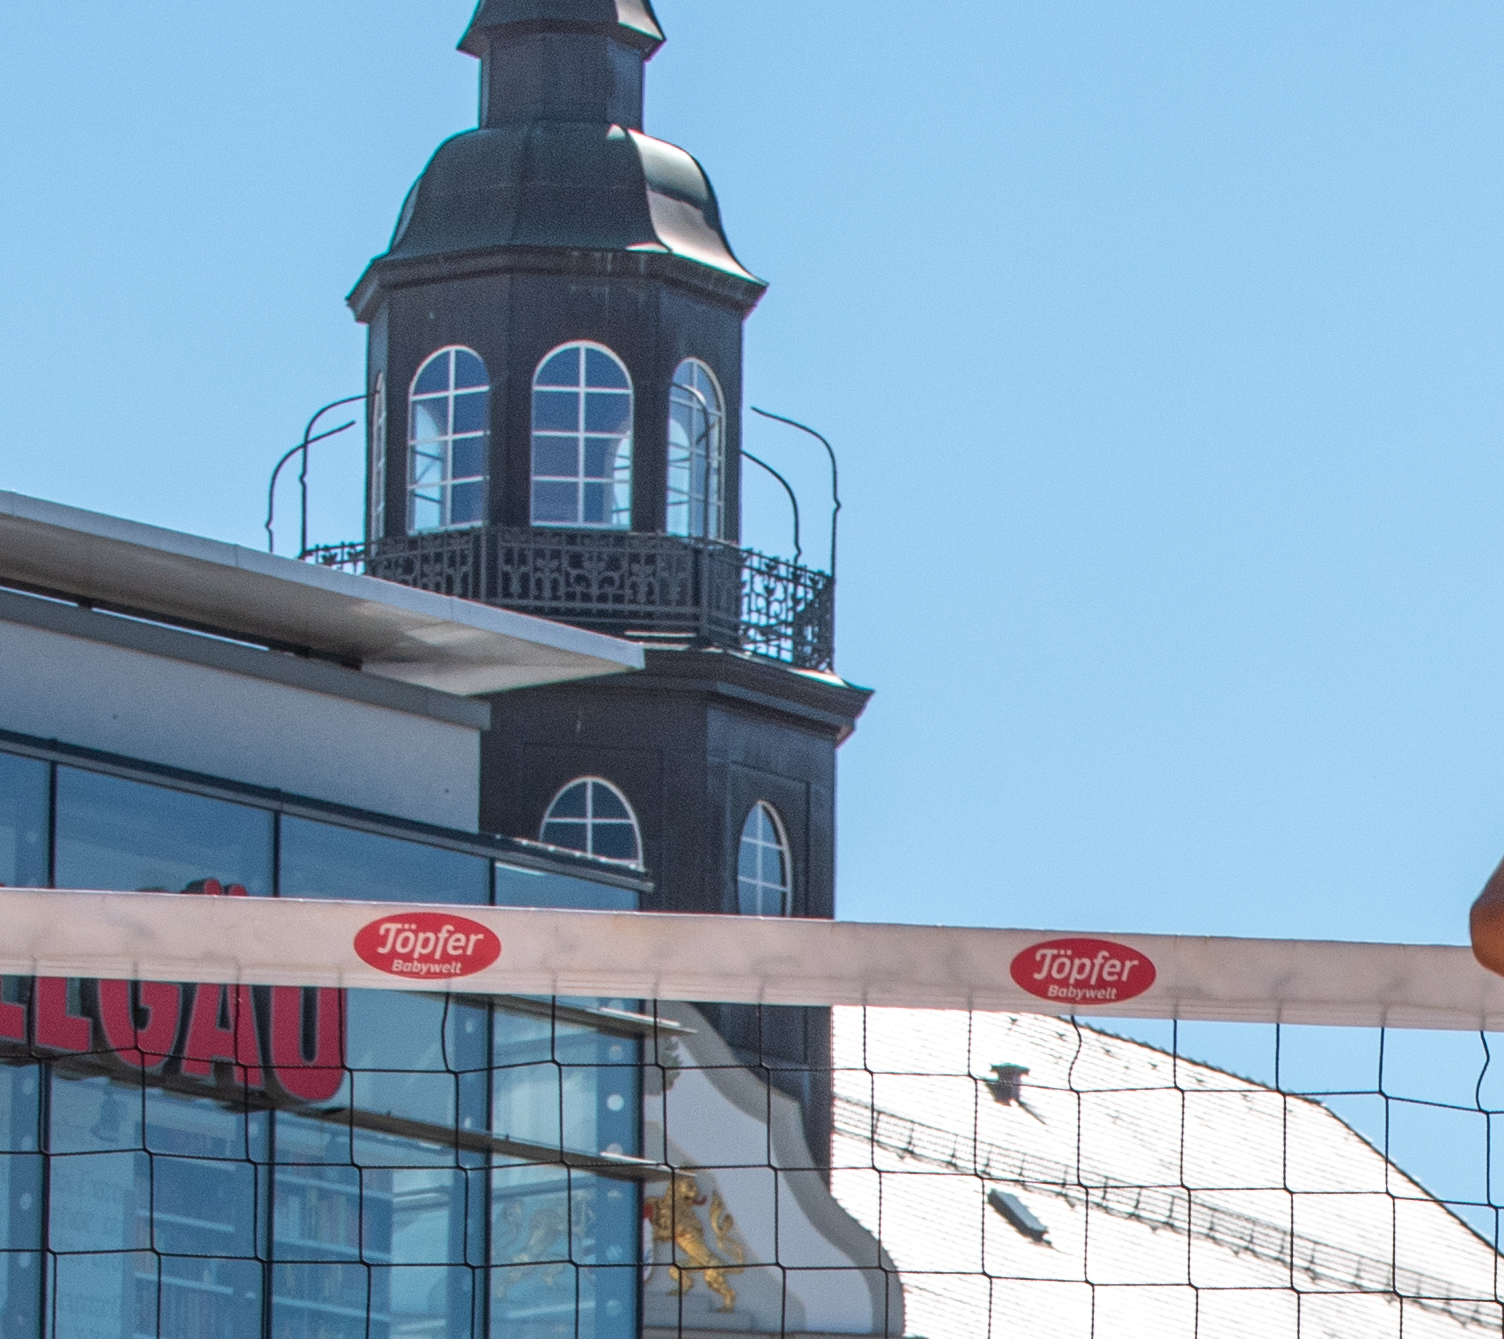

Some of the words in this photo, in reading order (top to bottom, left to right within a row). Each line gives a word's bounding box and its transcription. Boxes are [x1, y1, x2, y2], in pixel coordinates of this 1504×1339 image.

[376, 922, 485, 960] Töpfer
[391, 959, 462, 975] Babywelt
[1032, 948, 1139, 986] Töpfer
[1047, 985, 1118, 1001] Babywelt
